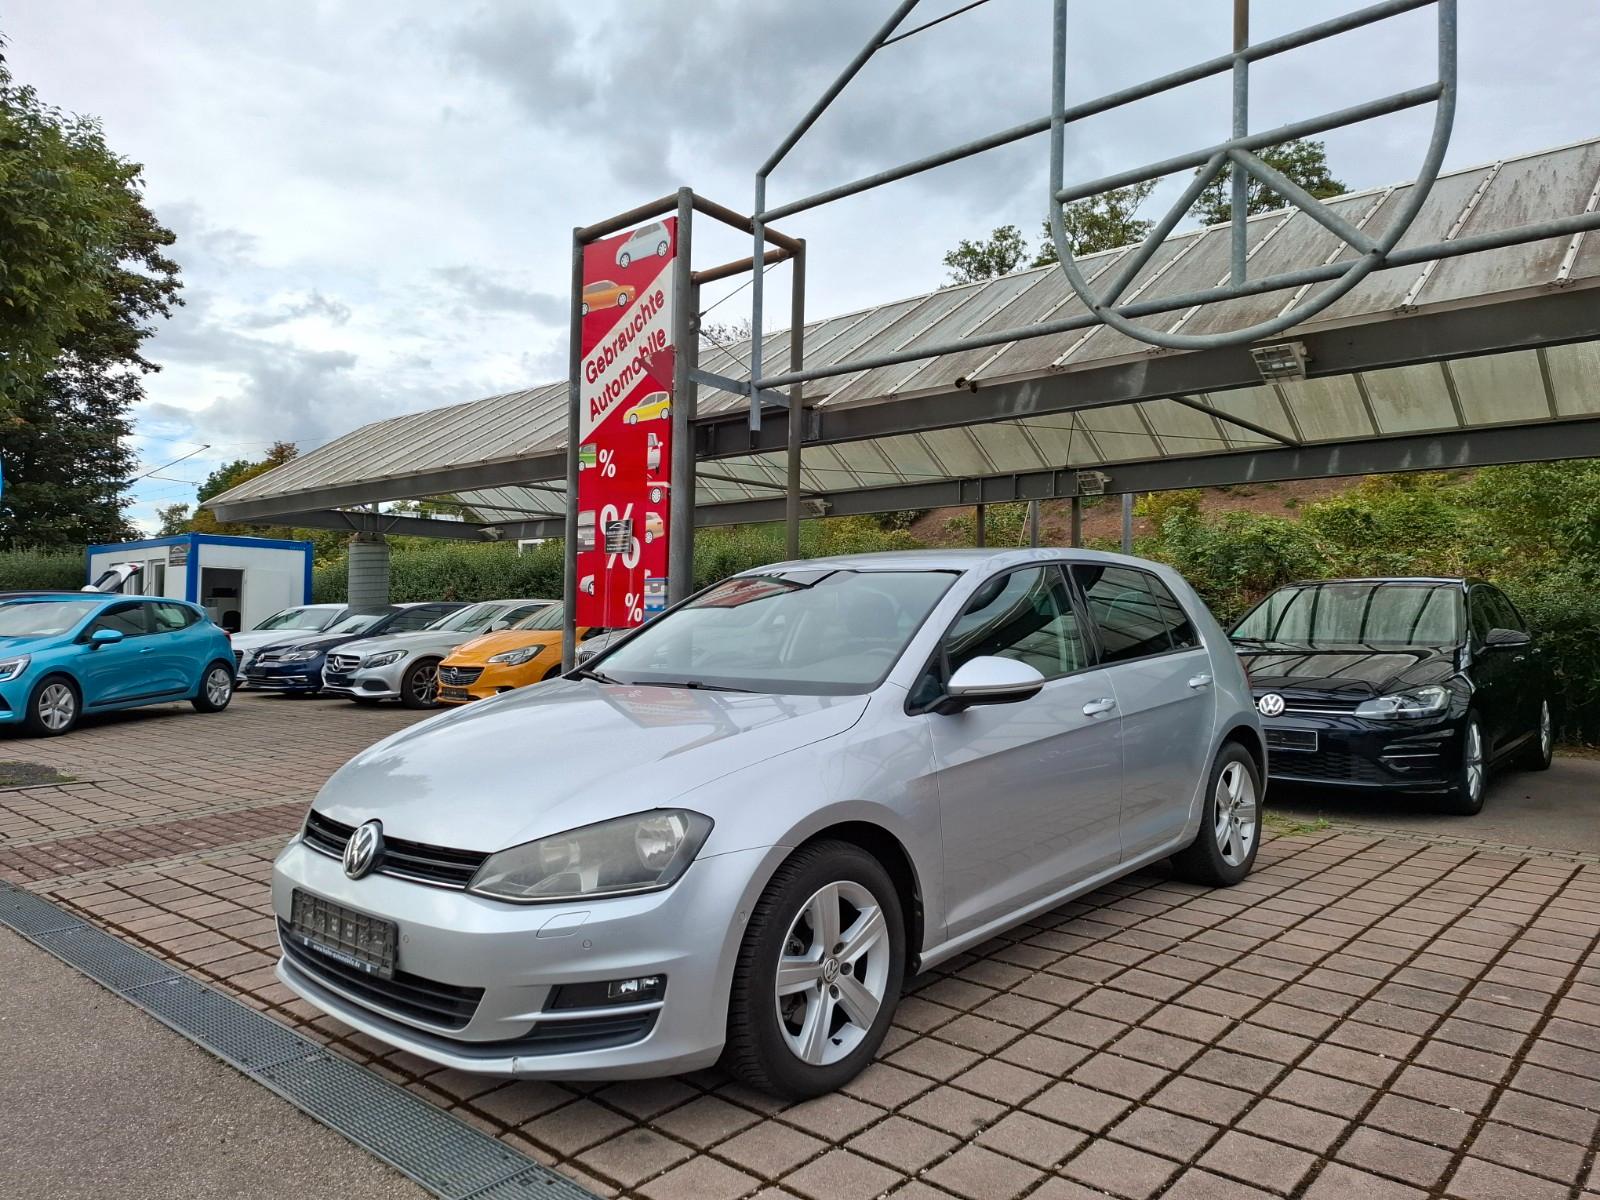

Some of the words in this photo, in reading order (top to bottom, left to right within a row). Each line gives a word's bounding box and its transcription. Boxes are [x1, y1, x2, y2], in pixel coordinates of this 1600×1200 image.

[585, 288, 665, 384] Gebrauchte
[599, 449, 616, 478] %
[625, 592, 643, 622] %
